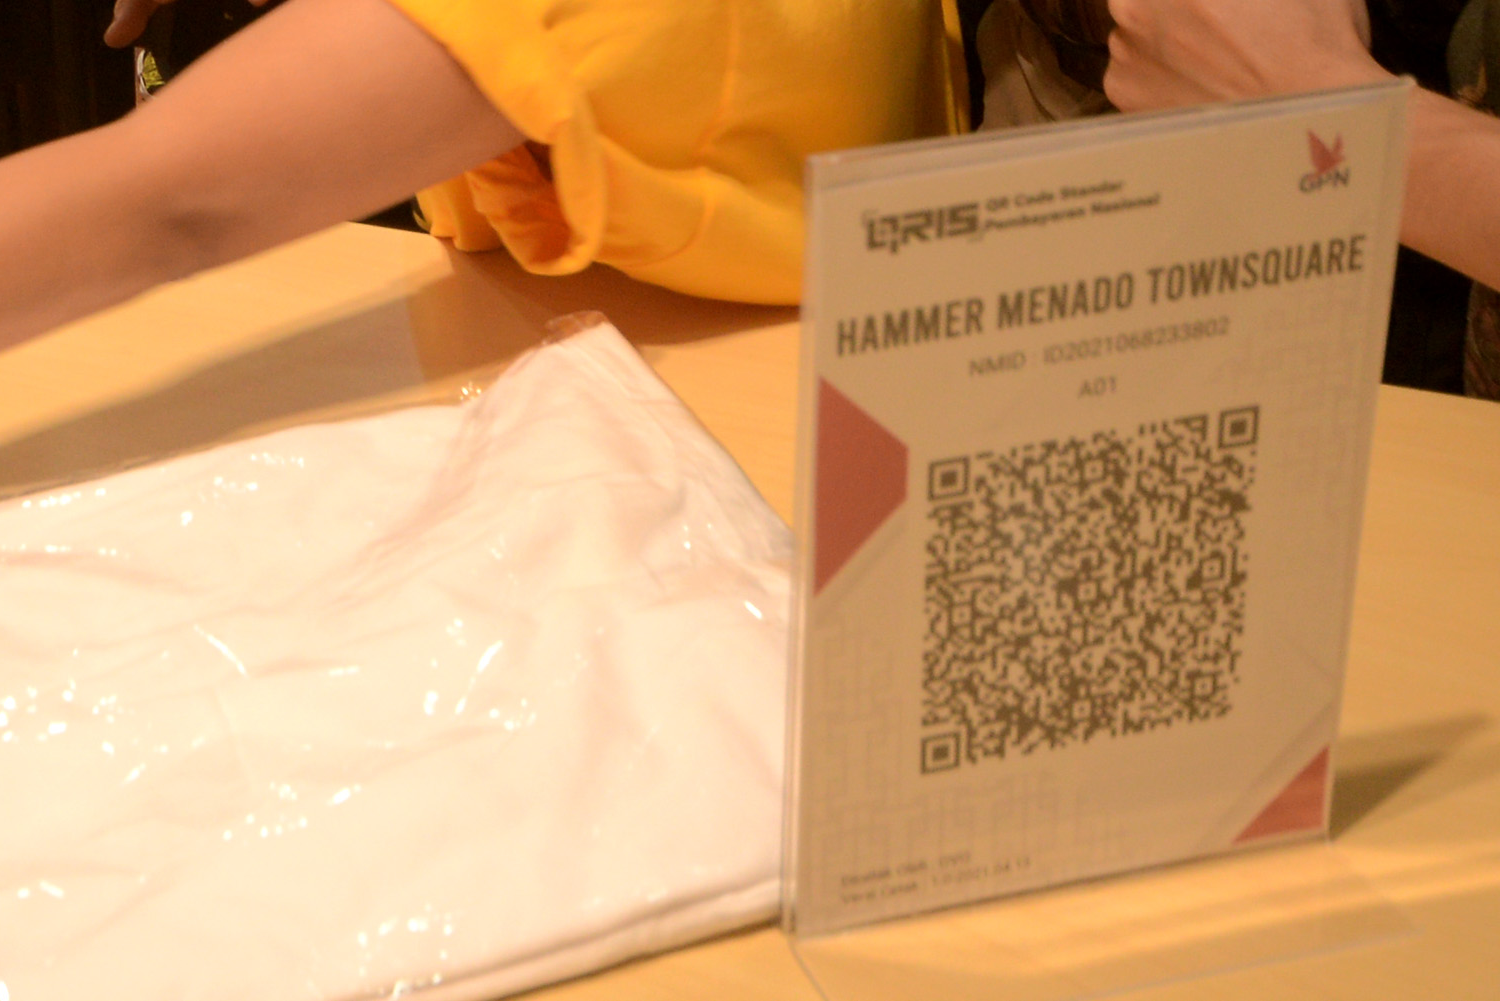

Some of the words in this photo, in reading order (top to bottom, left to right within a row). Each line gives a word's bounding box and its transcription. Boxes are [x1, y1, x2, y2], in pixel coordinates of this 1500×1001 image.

[835, 297, 985, 358] HAMMER
[997, 271, 1135, 331] MENADO
[1146, 233, 1367, 304] TOWNSQUARE
[968, 350, 1027, 377] NMID
[1078, 374, 1118, 400] A01
